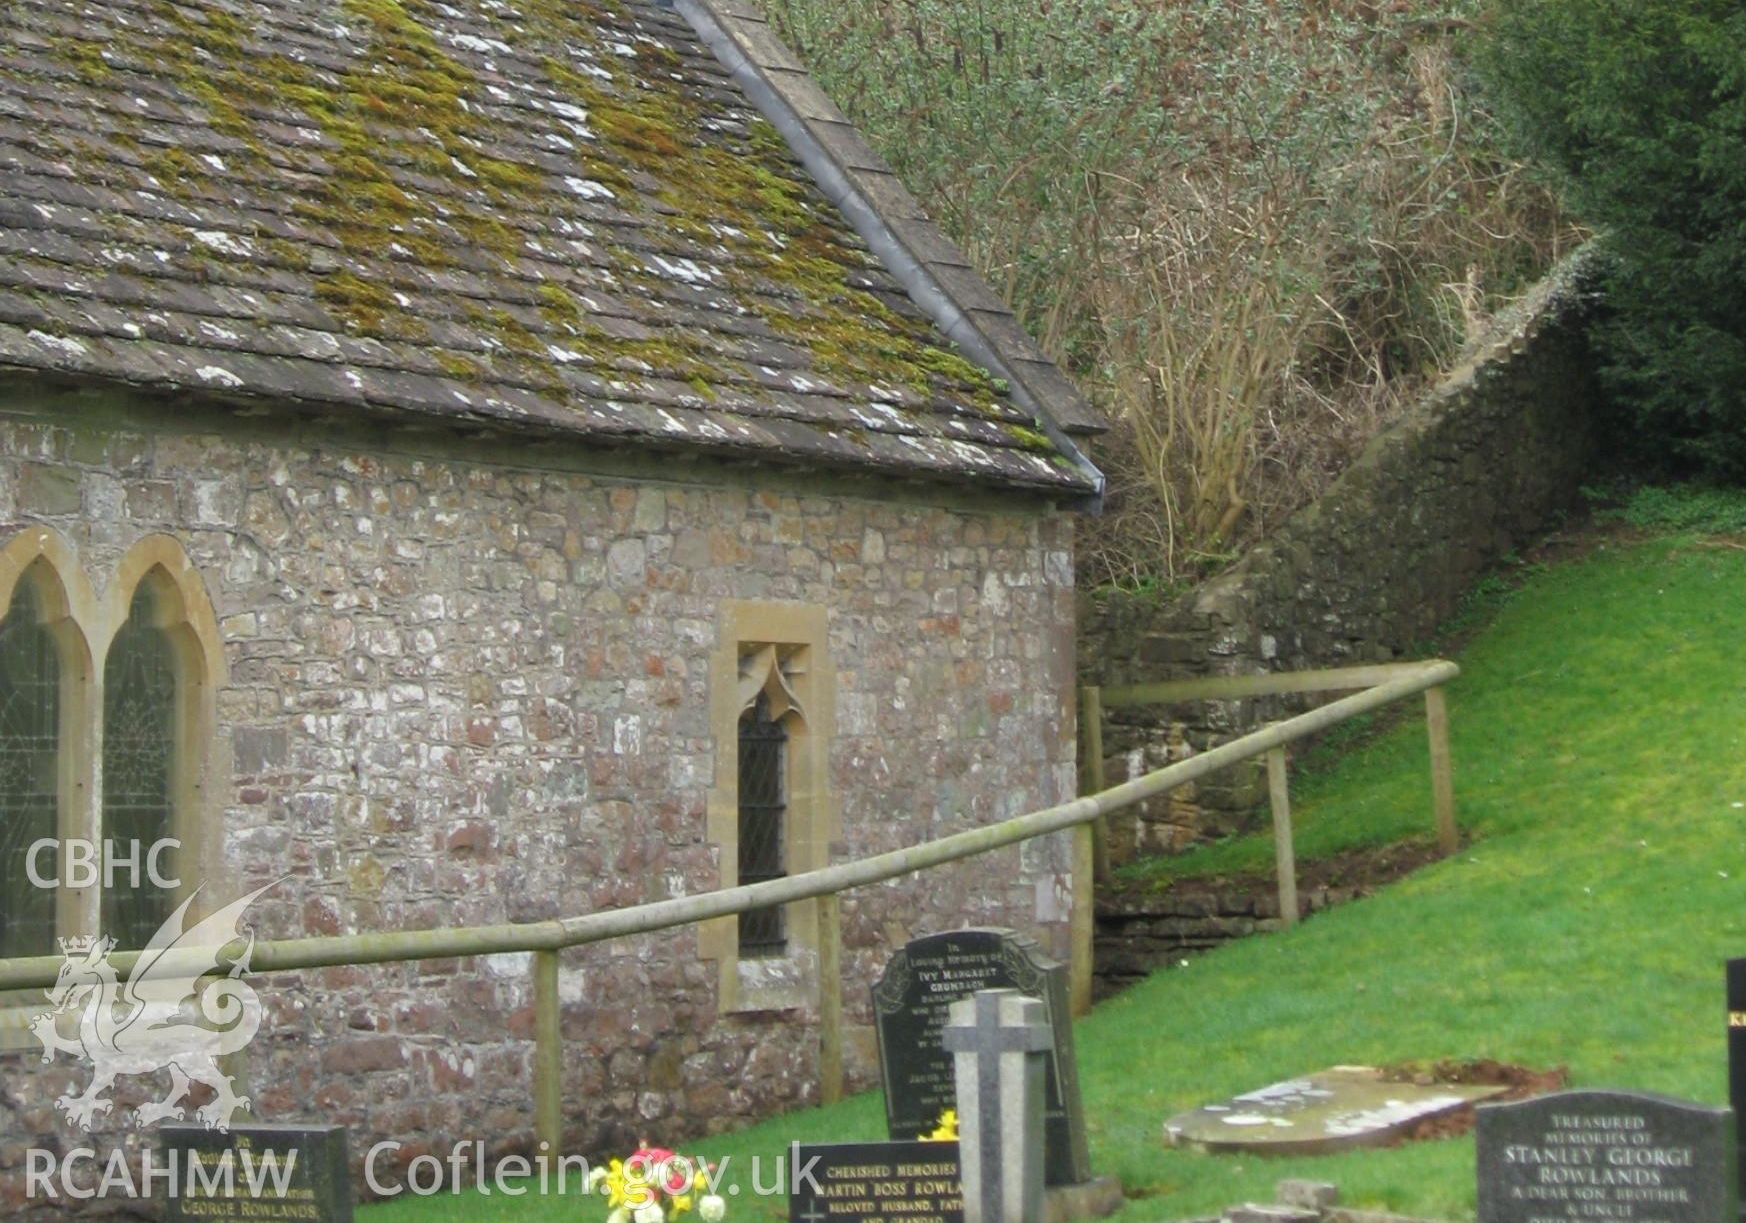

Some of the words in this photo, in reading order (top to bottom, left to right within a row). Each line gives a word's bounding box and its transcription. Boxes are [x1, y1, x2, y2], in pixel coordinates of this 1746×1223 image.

[919, 970, 938, 981] IVY
[942, 967, 997, 980] MARGARET
[1552, 1115, 1645, 1129] TREASURED
[1545, 1132, 1627, 1145] MEMORIES
[1632, 1132, 1652, 1145] OF
[1504, 1146, 1596, 1164] STANLEY
[1607, 1148, 1693, 1167] GEORGE
[826, 1165, 890, 1178] CHERISHED
[897, 1163, 957, 1177] MEMORIES
[1540, 1167, 1662, 1186] ROWLANDS
[915, 1181, 965, 1195] ROWLA
[1511, 1187, 1522, 1199] A
[1528, 1187, 1569, 1199] DEAR
[1616, 1188, 1689, 1202] BROTHER
[181, 1199, 235, 1215] GEORGE
[829, 1201, 875, 1213] BELOVED
[939, 1199, 965, 1211] FATH
[1583, 1205, 1633, 1217] UNCLE
